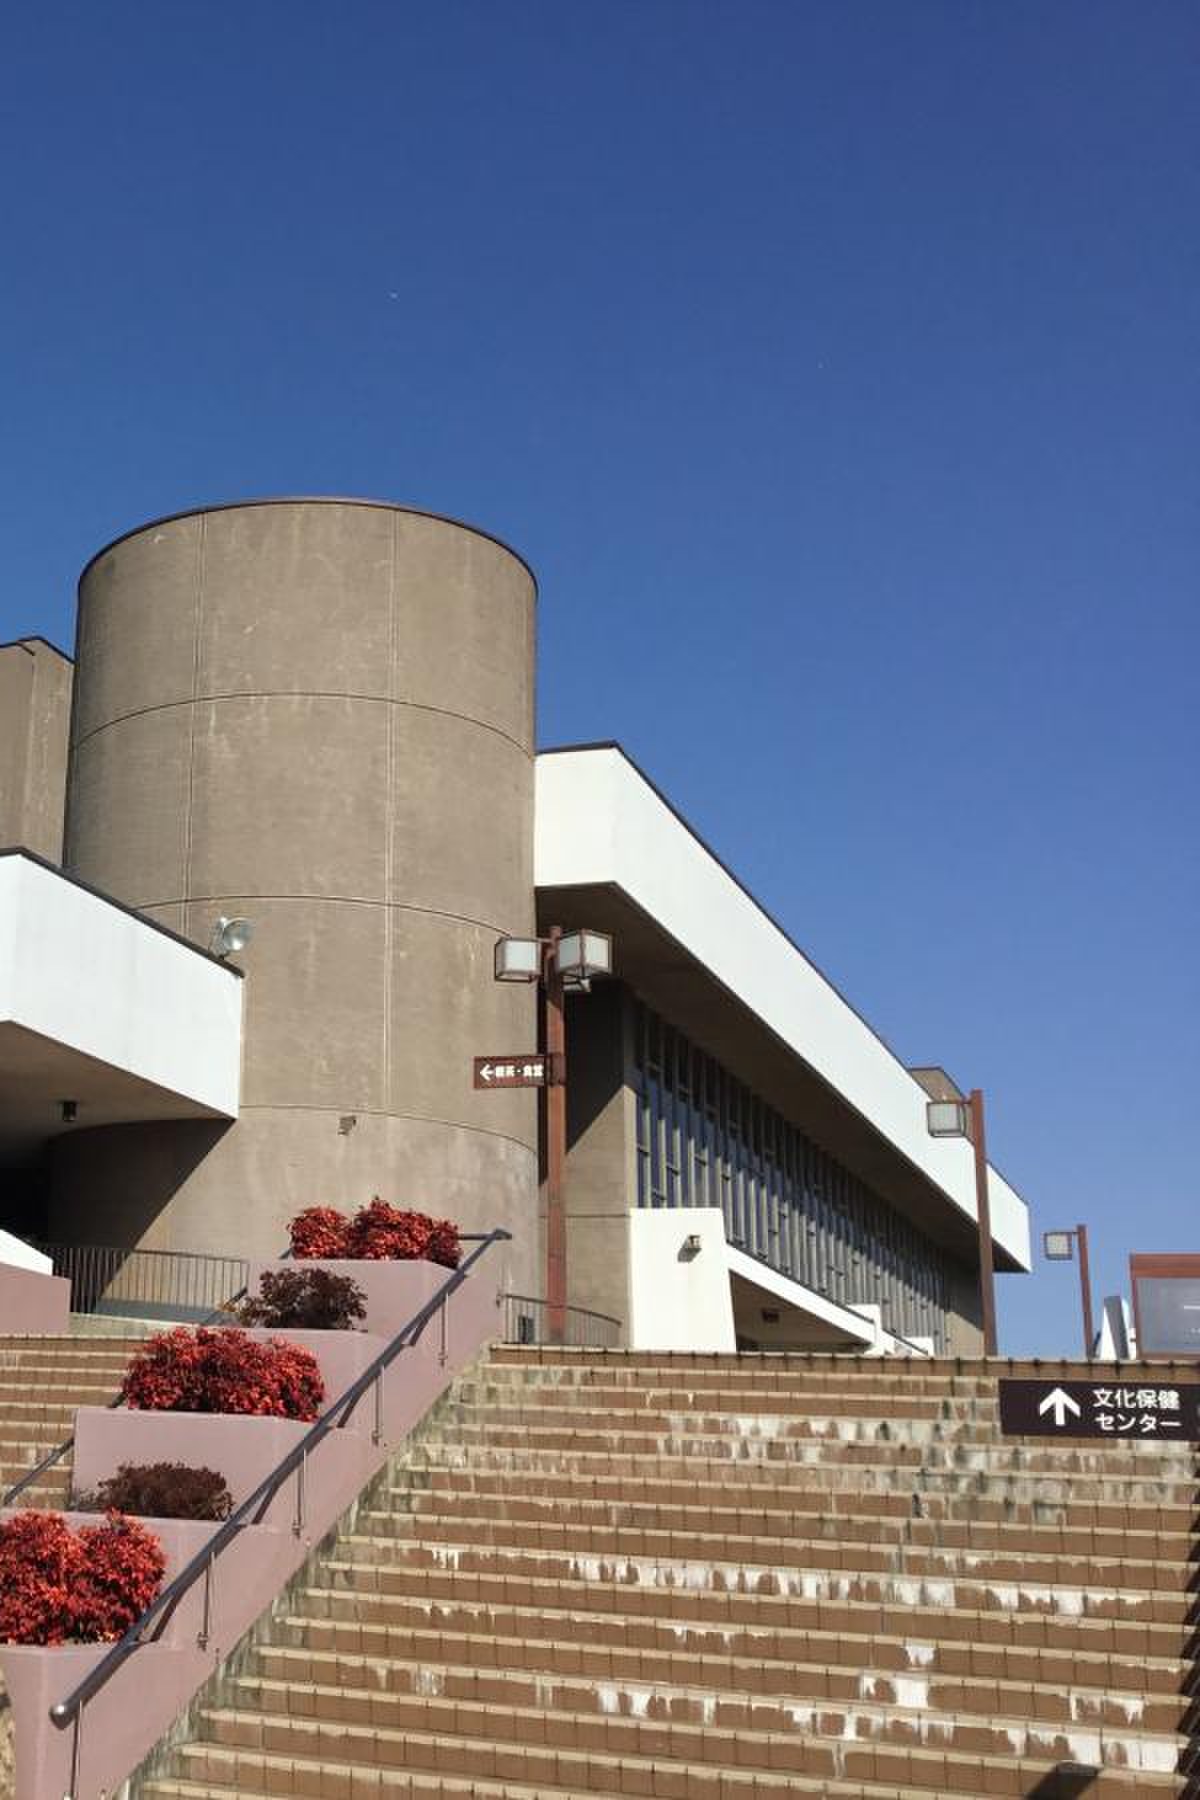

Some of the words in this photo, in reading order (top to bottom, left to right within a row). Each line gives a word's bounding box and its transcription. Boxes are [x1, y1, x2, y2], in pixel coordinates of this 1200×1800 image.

[1092, 1388, 1180, 1410] 文化保健
[1093, 1413, 1182, 1433] センター
